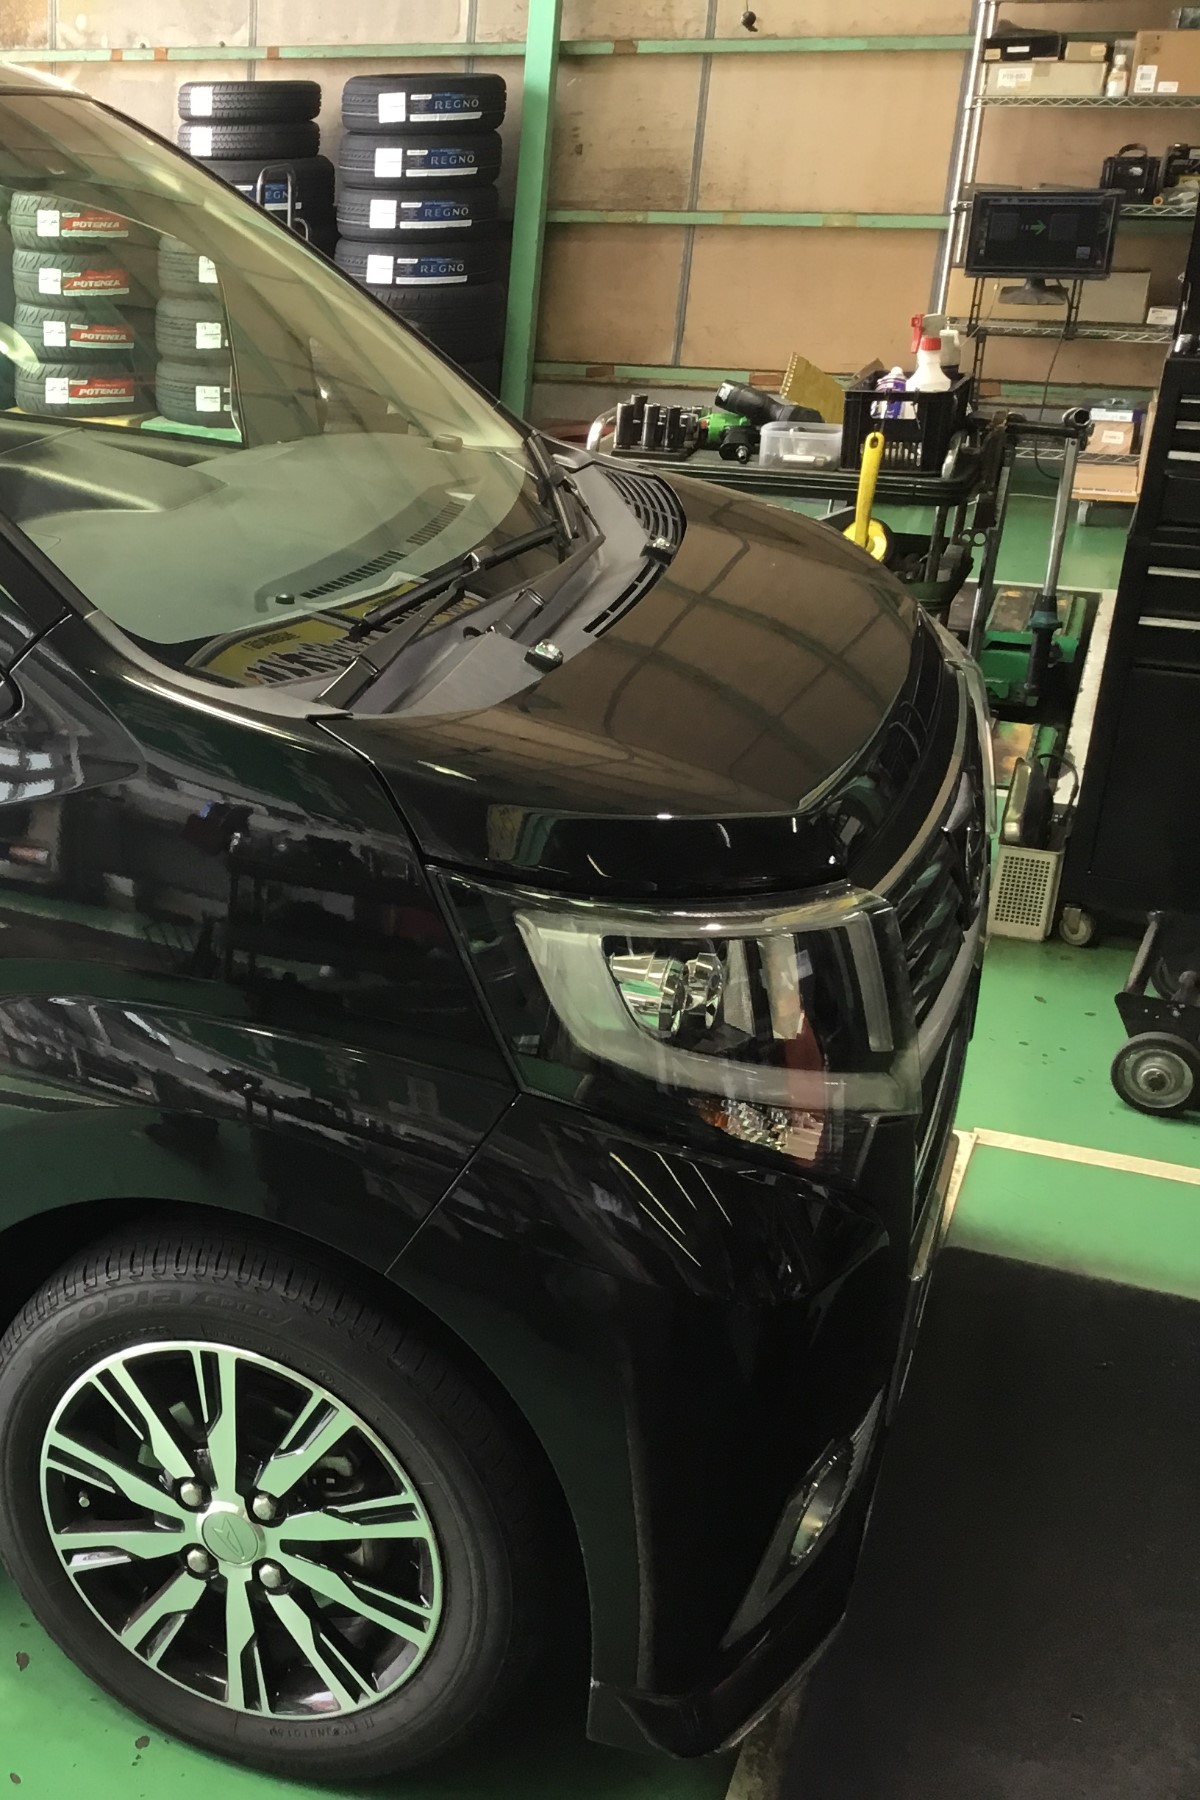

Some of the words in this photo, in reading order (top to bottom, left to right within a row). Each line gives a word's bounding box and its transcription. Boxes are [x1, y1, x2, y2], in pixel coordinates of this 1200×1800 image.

[434, 98, 480, 110] REGNO
[430, 154, 475, 166] REGNO
[424, 207, 469, 218] REGNO
[71, 220, 120, 228] POTENZA
[420, 263, 465, 274] REGNO
[73, 279, 121, 287] POTENZA
[79, 332, 127, 341] POTENZA
[78, 387, 126, 396] POTENZA
